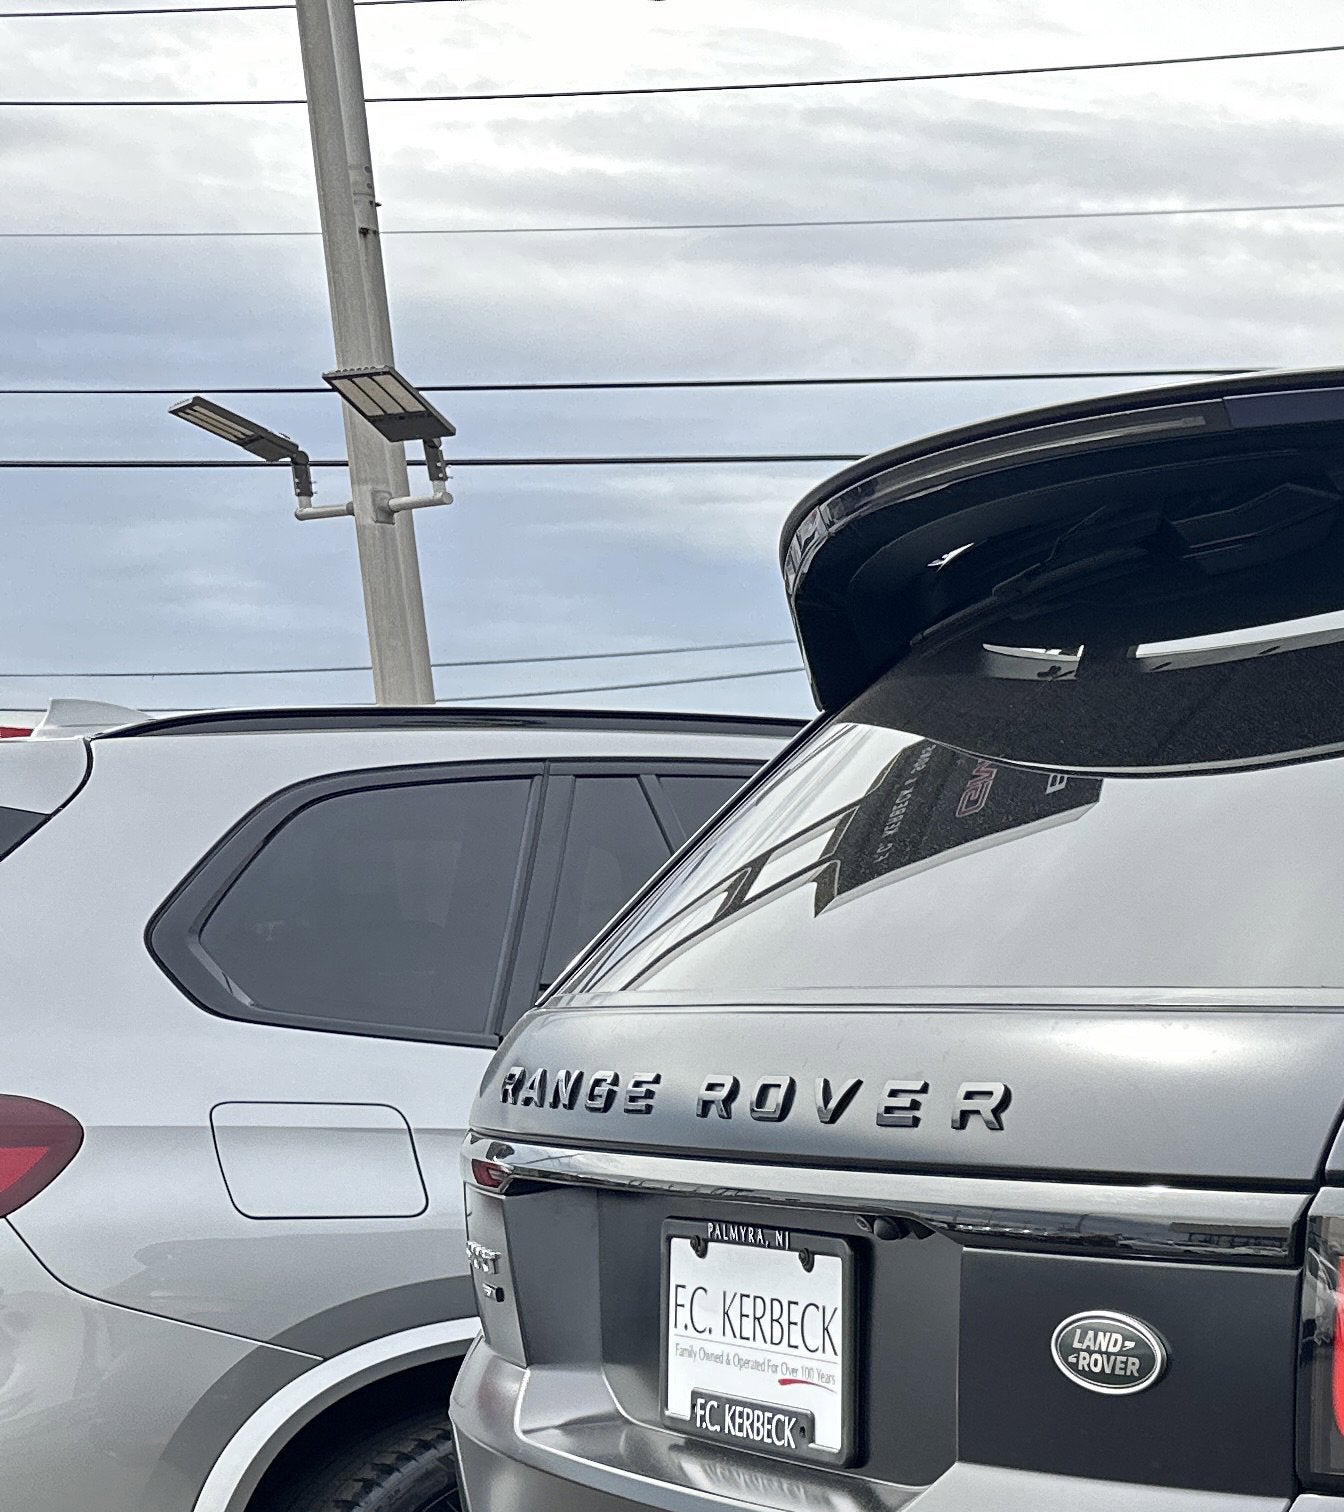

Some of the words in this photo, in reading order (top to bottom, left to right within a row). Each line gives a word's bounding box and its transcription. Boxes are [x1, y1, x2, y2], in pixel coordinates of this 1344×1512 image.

[500, 1066, 662, 1114] RANGE
[696, 1074, 1012, 1130] ROVER
[707, 1222, 769, 1248] PALMYRA,
[775, 1230, 790, 1250] NJ
[674, 1284, 713, 1335] F.C.
[722, 1290, 838, 1357] KERBECK
[1072, 1328, 1123, 1353] LAND
[675, 1343, 697, 1362] Family
[699, 1347, 724, 1365] Owned
[725, 1354, 731, 1366] &
[733, 1354, 766, 1373] Operated
[767, 1359, 779, 1374] For
[781, 1362, 799, 1376] Over
[801, 1366, 814, 1380] 100
[817, 1368, 836, 1385] Years
[1078, 1351, 1140, 1377] ROVER
[695, 1398, 721, 1433] F.C.
[724, 1402, 797, 1449] KERBECK
